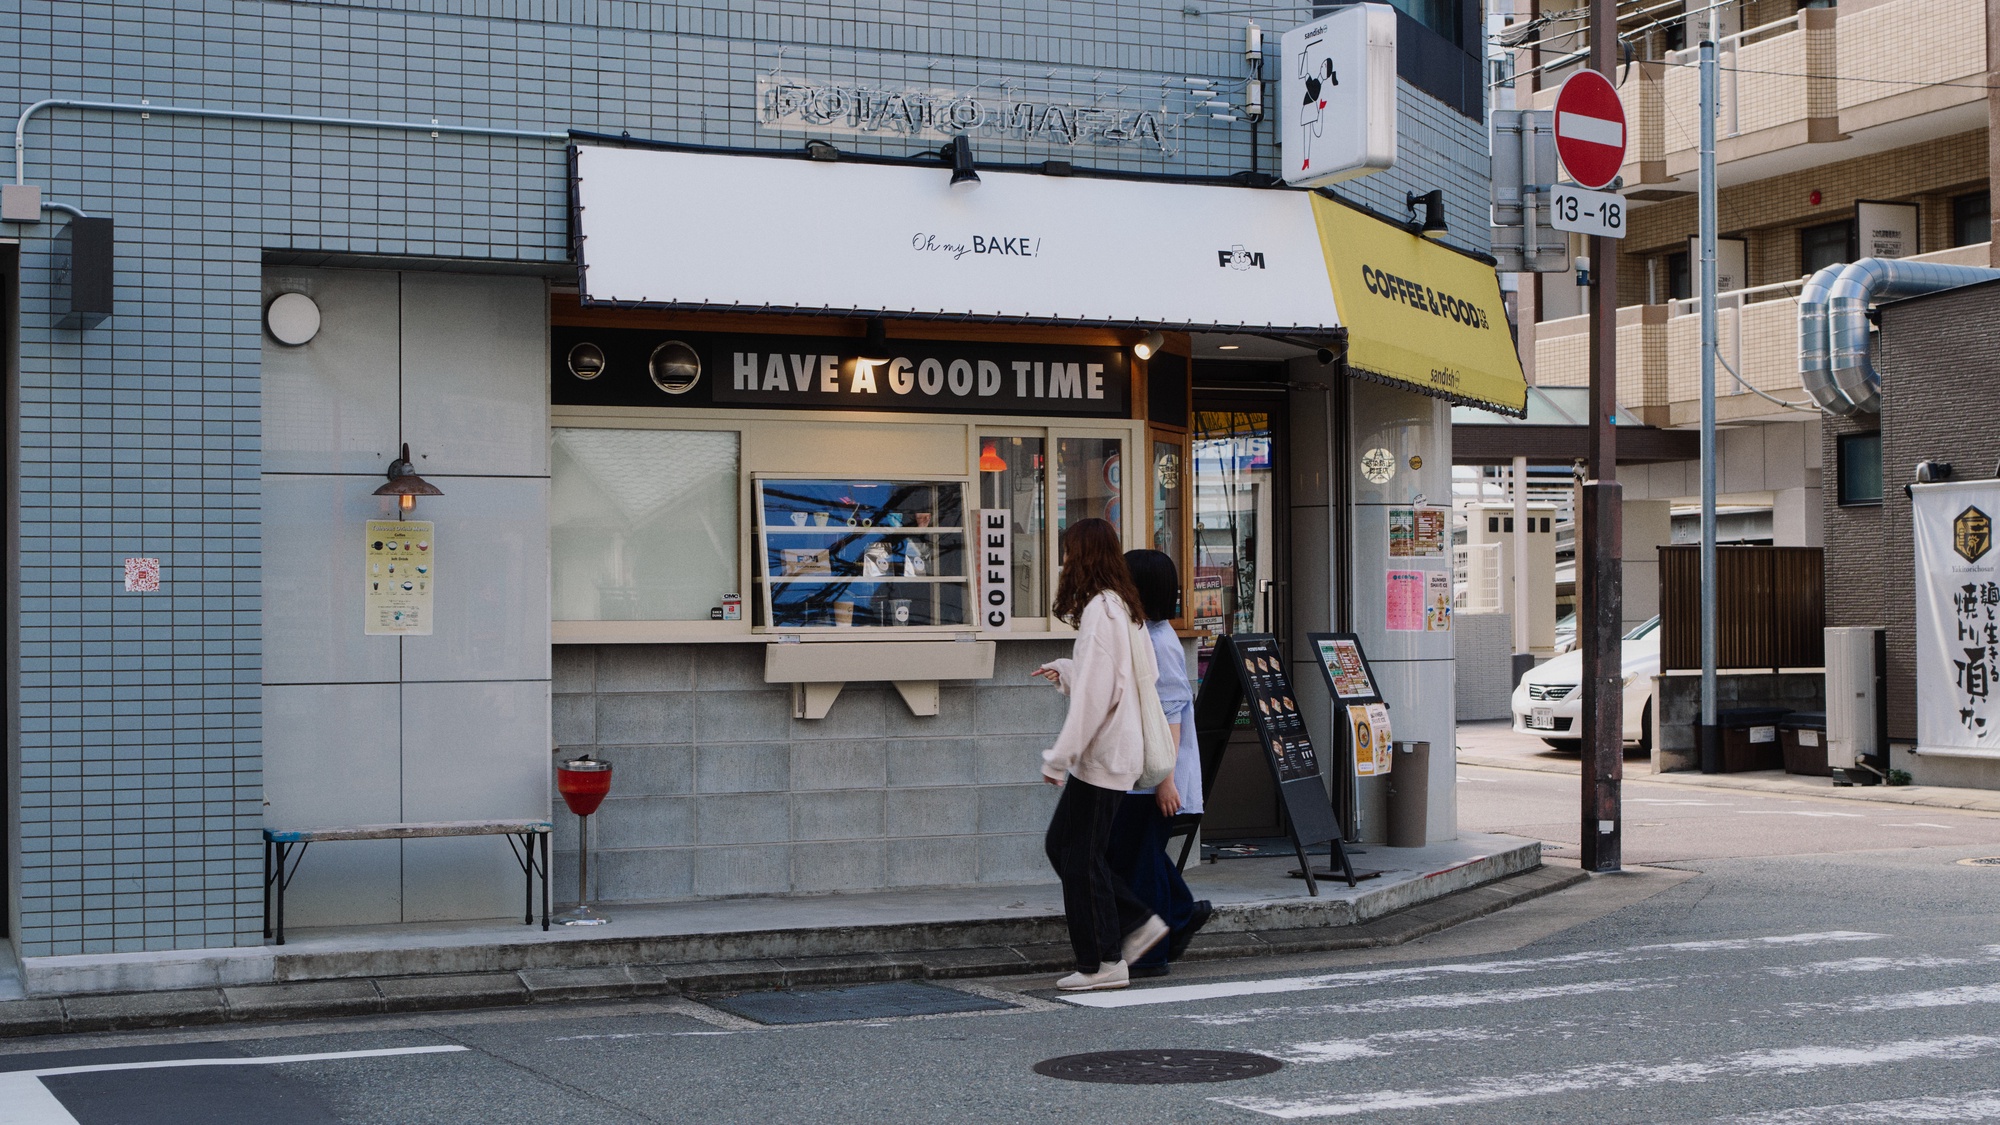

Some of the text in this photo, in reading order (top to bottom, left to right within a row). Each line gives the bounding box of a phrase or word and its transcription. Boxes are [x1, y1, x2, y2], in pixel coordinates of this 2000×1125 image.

[1304, 27, 1324, 40] sandish
[775, 84, 1166, 147] POTATO MAFIA
[1555, 195, 1621, 229] 13-18
[912, 232, 940, 251] Oh
[943, 242, 972, 260] my
[1362, 264, 1481, 329] COFFEE & FOOD
[1477, 308, 1486, 319] TO
[733, 352, 1105, 399] HAVE A GOOD TIME
[1430, 367, 1455, 388] sandish
[987, 514, 1005, 628] COFFEE
